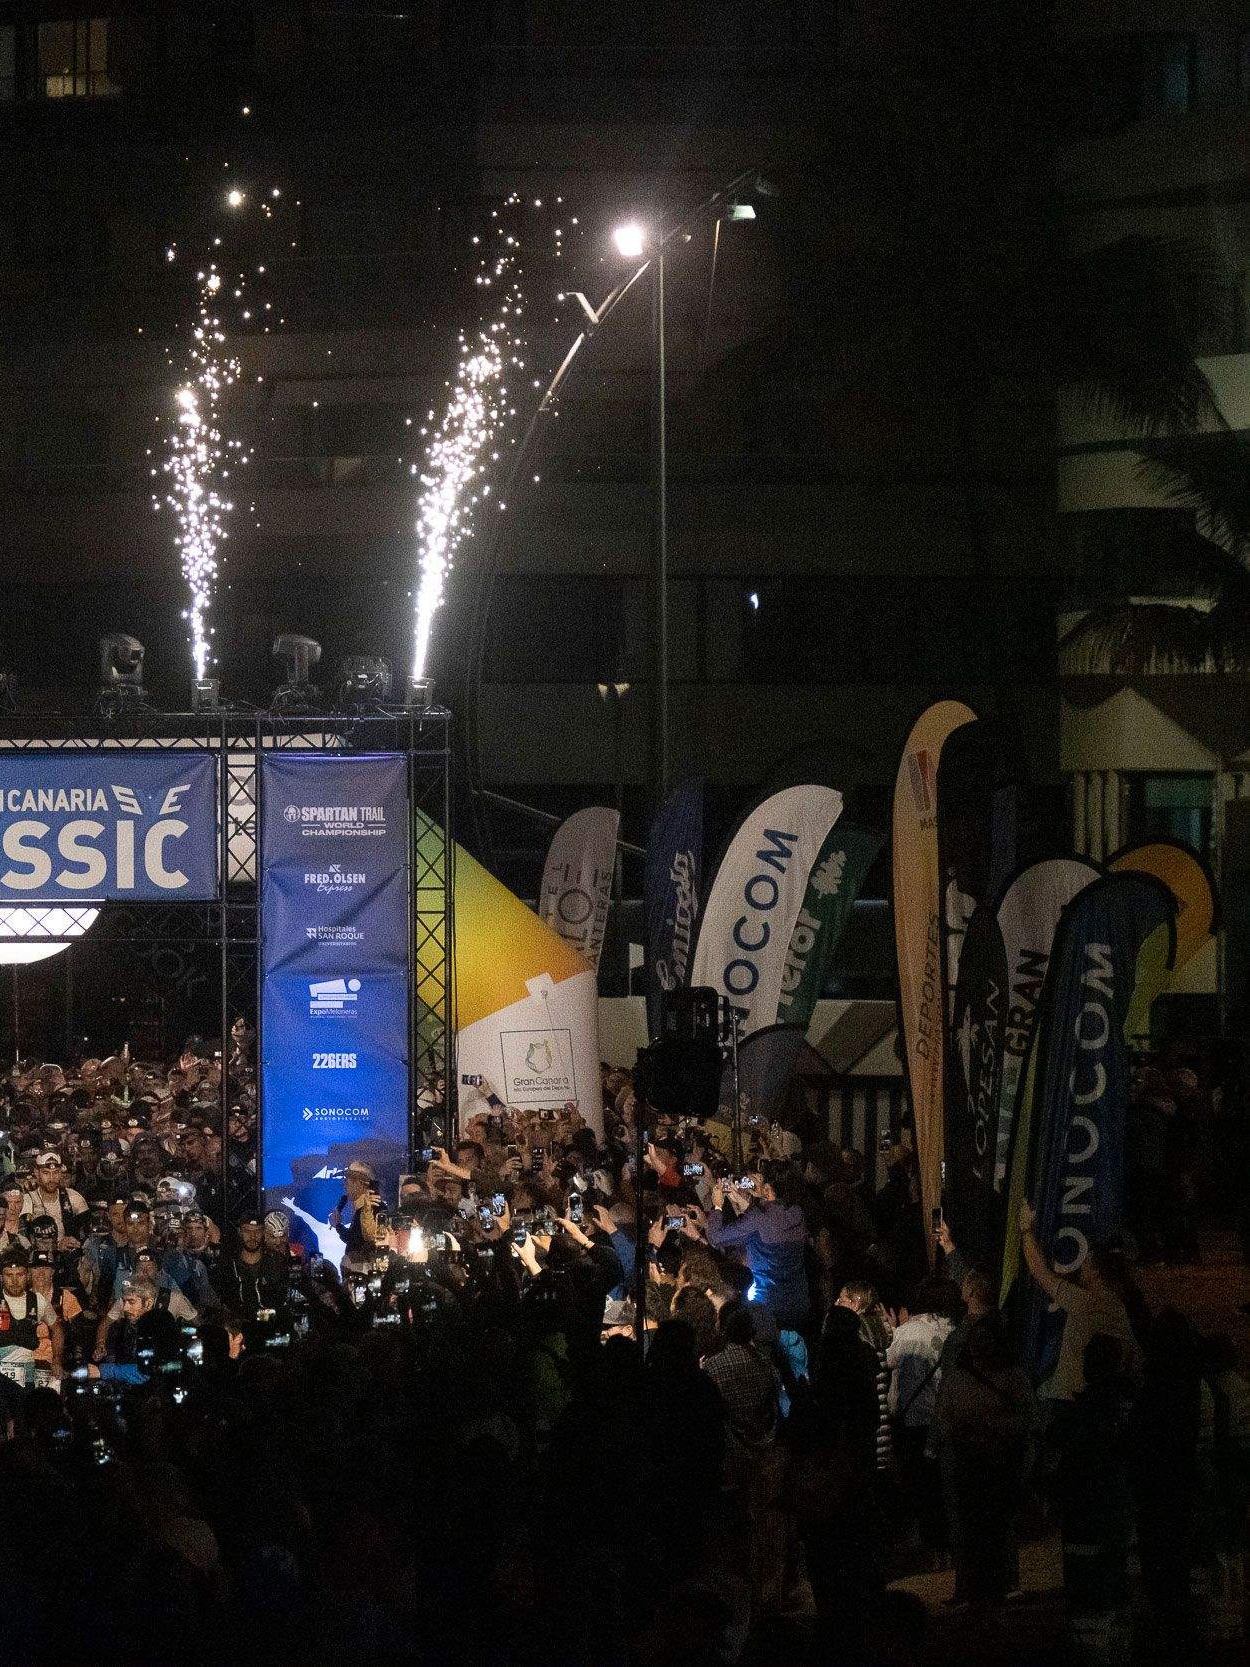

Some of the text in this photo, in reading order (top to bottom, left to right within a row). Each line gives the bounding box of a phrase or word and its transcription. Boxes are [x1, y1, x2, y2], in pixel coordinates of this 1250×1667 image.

[7, 788, 109, 812] CANARIA
[301, 807, 386, 821] SPARTAN TRAIL
[317, 882, 353, 894] Express
[588, 870, 612, 966] ANTERAS
[723, 828, 798, 998] OCOM
[318, 925, 356, 933] Hospitales
[916, 910, 940, 1060] DEPORTES
[1004, 948, 1048, 1057] GRAN
[312, 1053, 357, 1069] 226ERS
[972, 978, 1002, 1181] LOPESAN
[315, 1108, 369, 1116] SONOCOM
[1052, 942, 1116, 1273] ONOCOM
